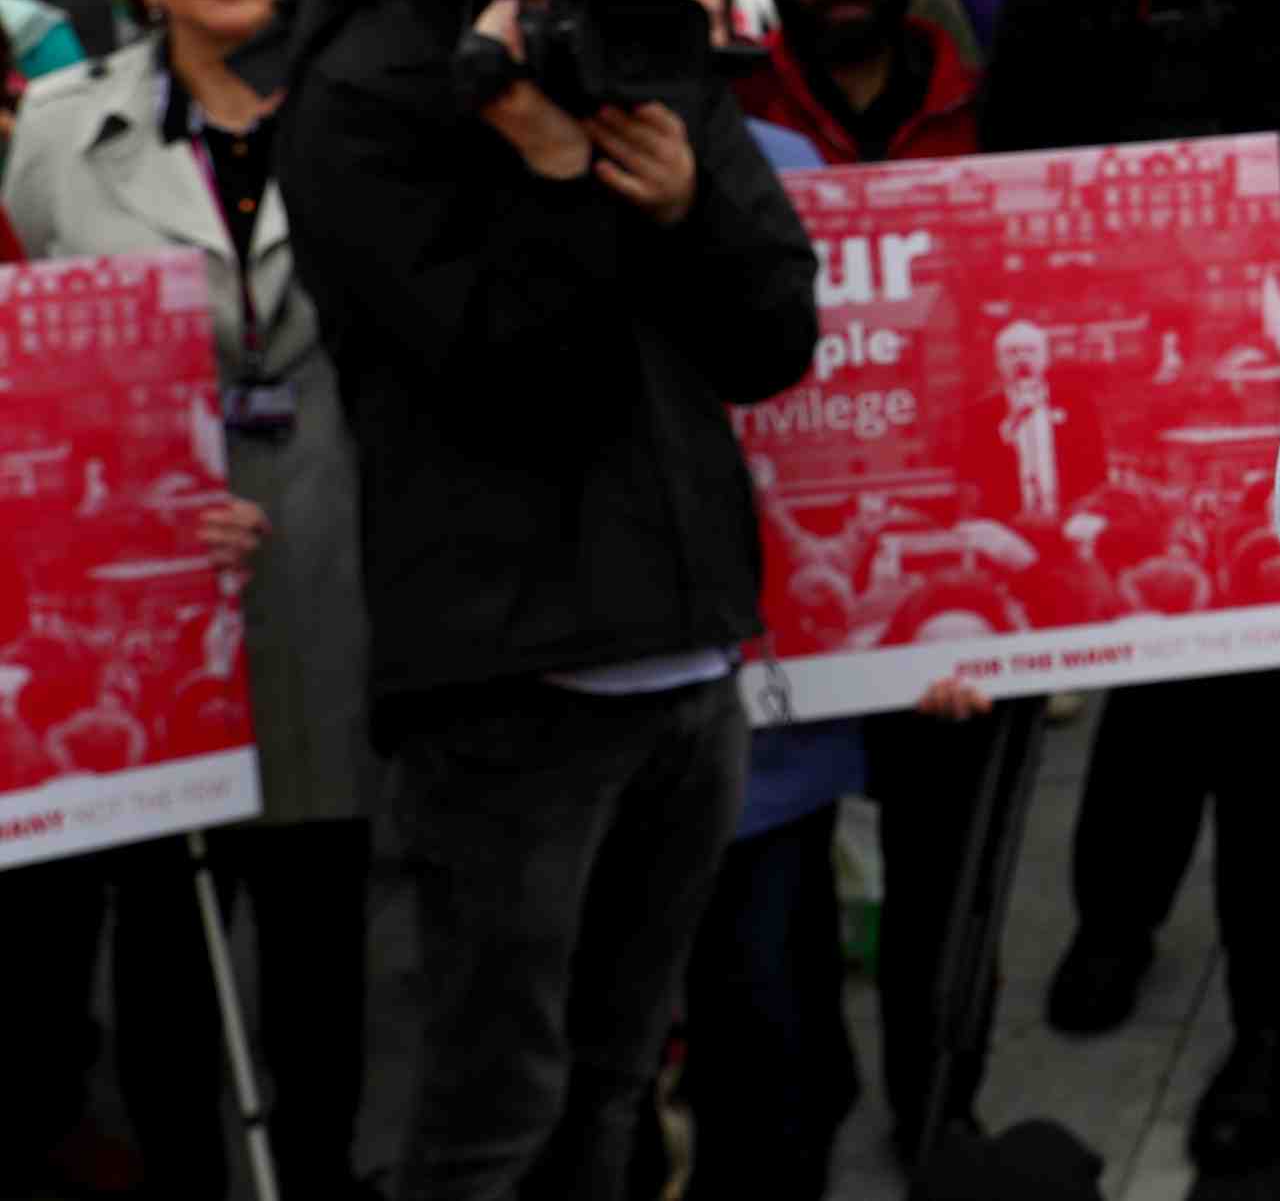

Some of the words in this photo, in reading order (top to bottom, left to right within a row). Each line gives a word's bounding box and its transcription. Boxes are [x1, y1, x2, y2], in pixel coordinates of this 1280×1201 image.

[815, 319, 907, 381] ple
[732, 388, 916, 440] rivilege
[1061, 644, 1135, 669] MANY
